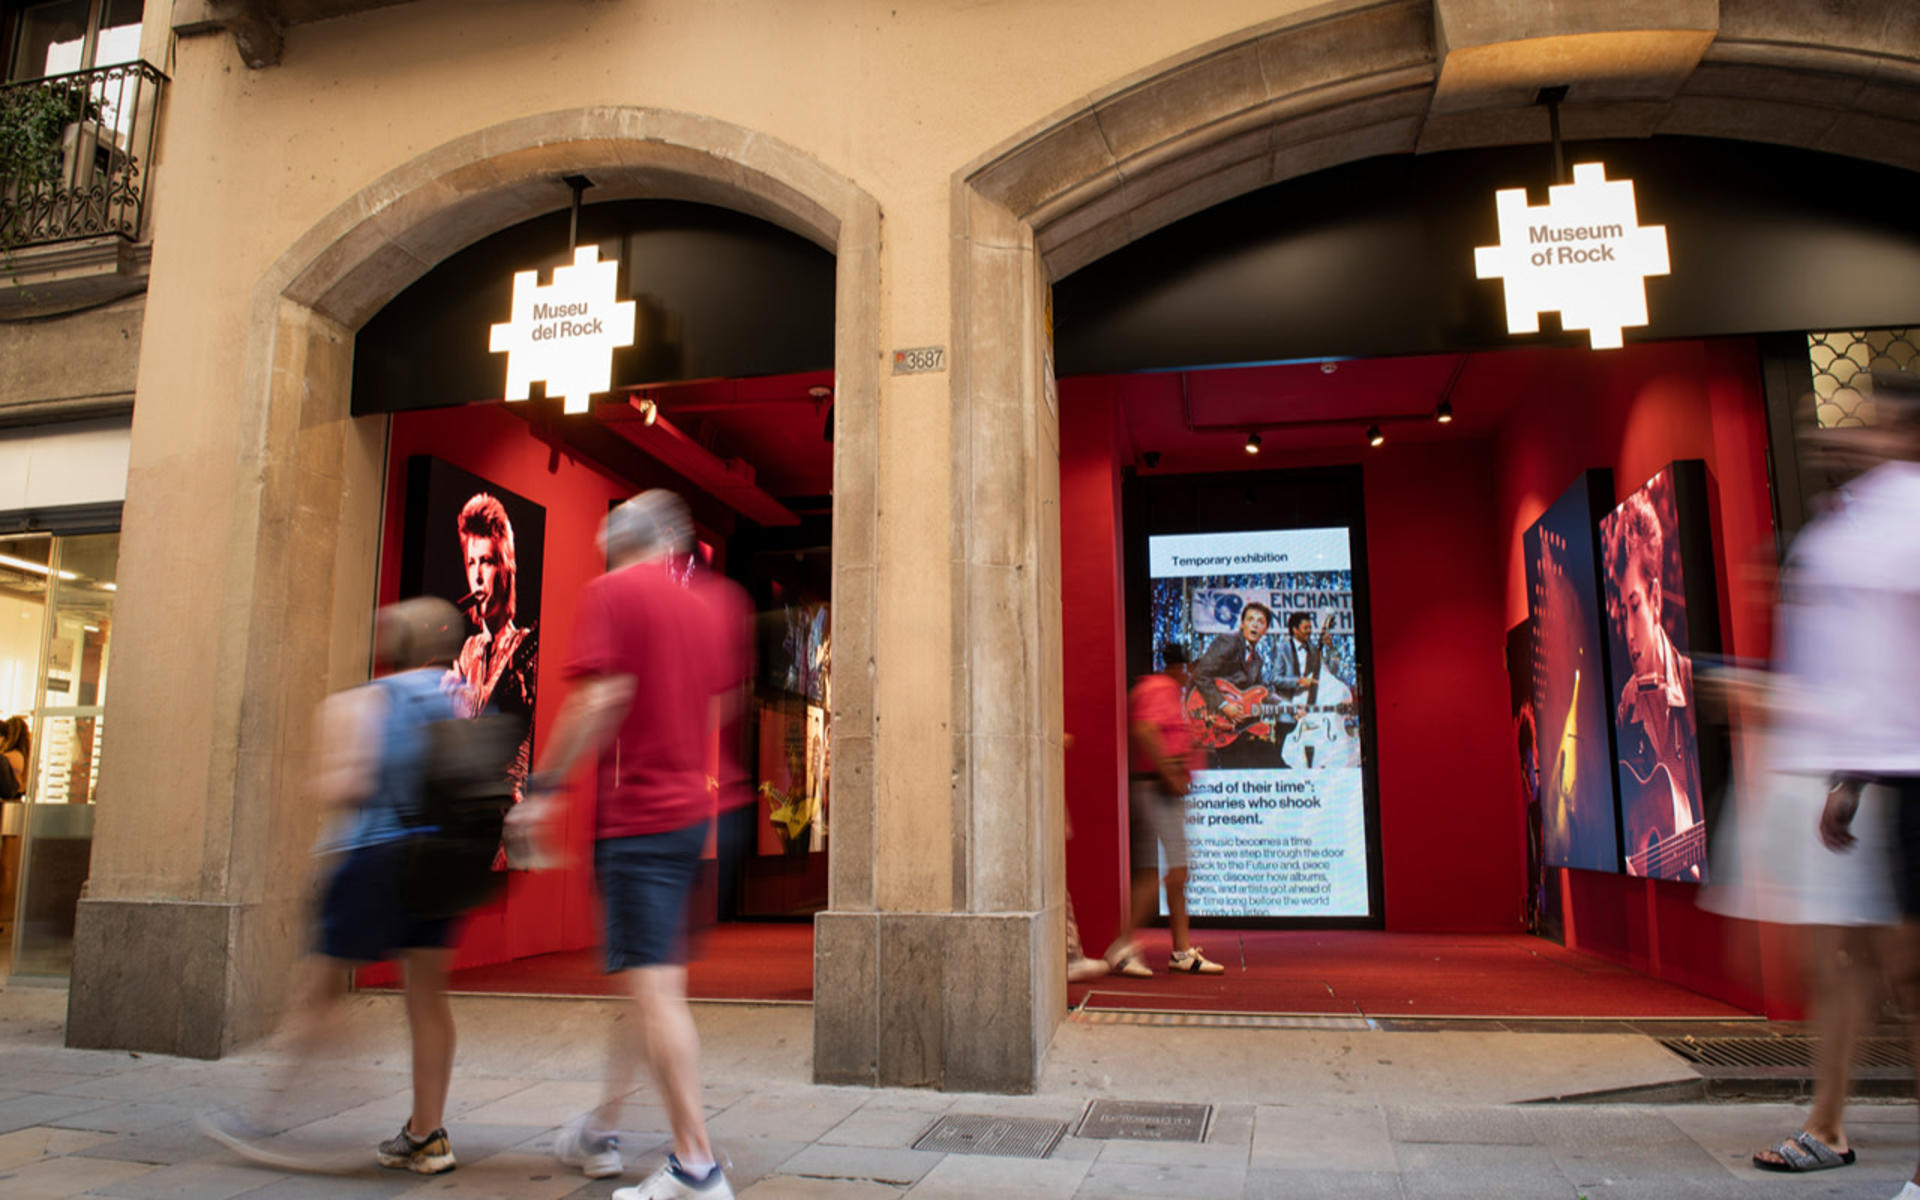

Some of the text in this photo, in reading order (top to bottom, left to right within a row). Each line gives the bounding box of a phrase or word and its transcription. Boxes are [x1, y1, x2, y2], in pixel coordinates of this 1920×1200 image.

[1529, 224, 1623, 244] Museum
[1531, 243, 1615, 267] of Rock
[533, 302, 588, 321] Museu
[532, 317, 603, 341] del Rock
[907, 349, 943, 369] 3687
[1172, 552, 1288, 567] Temporary exhibition
[1270, 592, 1351, 609] ENCHANT
[1269, 611, 1318, 629] NDR
[1225, 780, 1239, 794] of
[1242, 780, 1272, 794] their
[1275, 779, 1315, 793] time":
[1184, 794, 1321, 810] sionaries who shook
[1208, 812, 1263, 827] present.
[1263, 847, 1301, 859] through
[1303, 847, 1320, 858] the
[1321, 847, 1344, 858] door
[1246, 860, 1278, 871] Future
[1321, 882, 1332, 893] of
